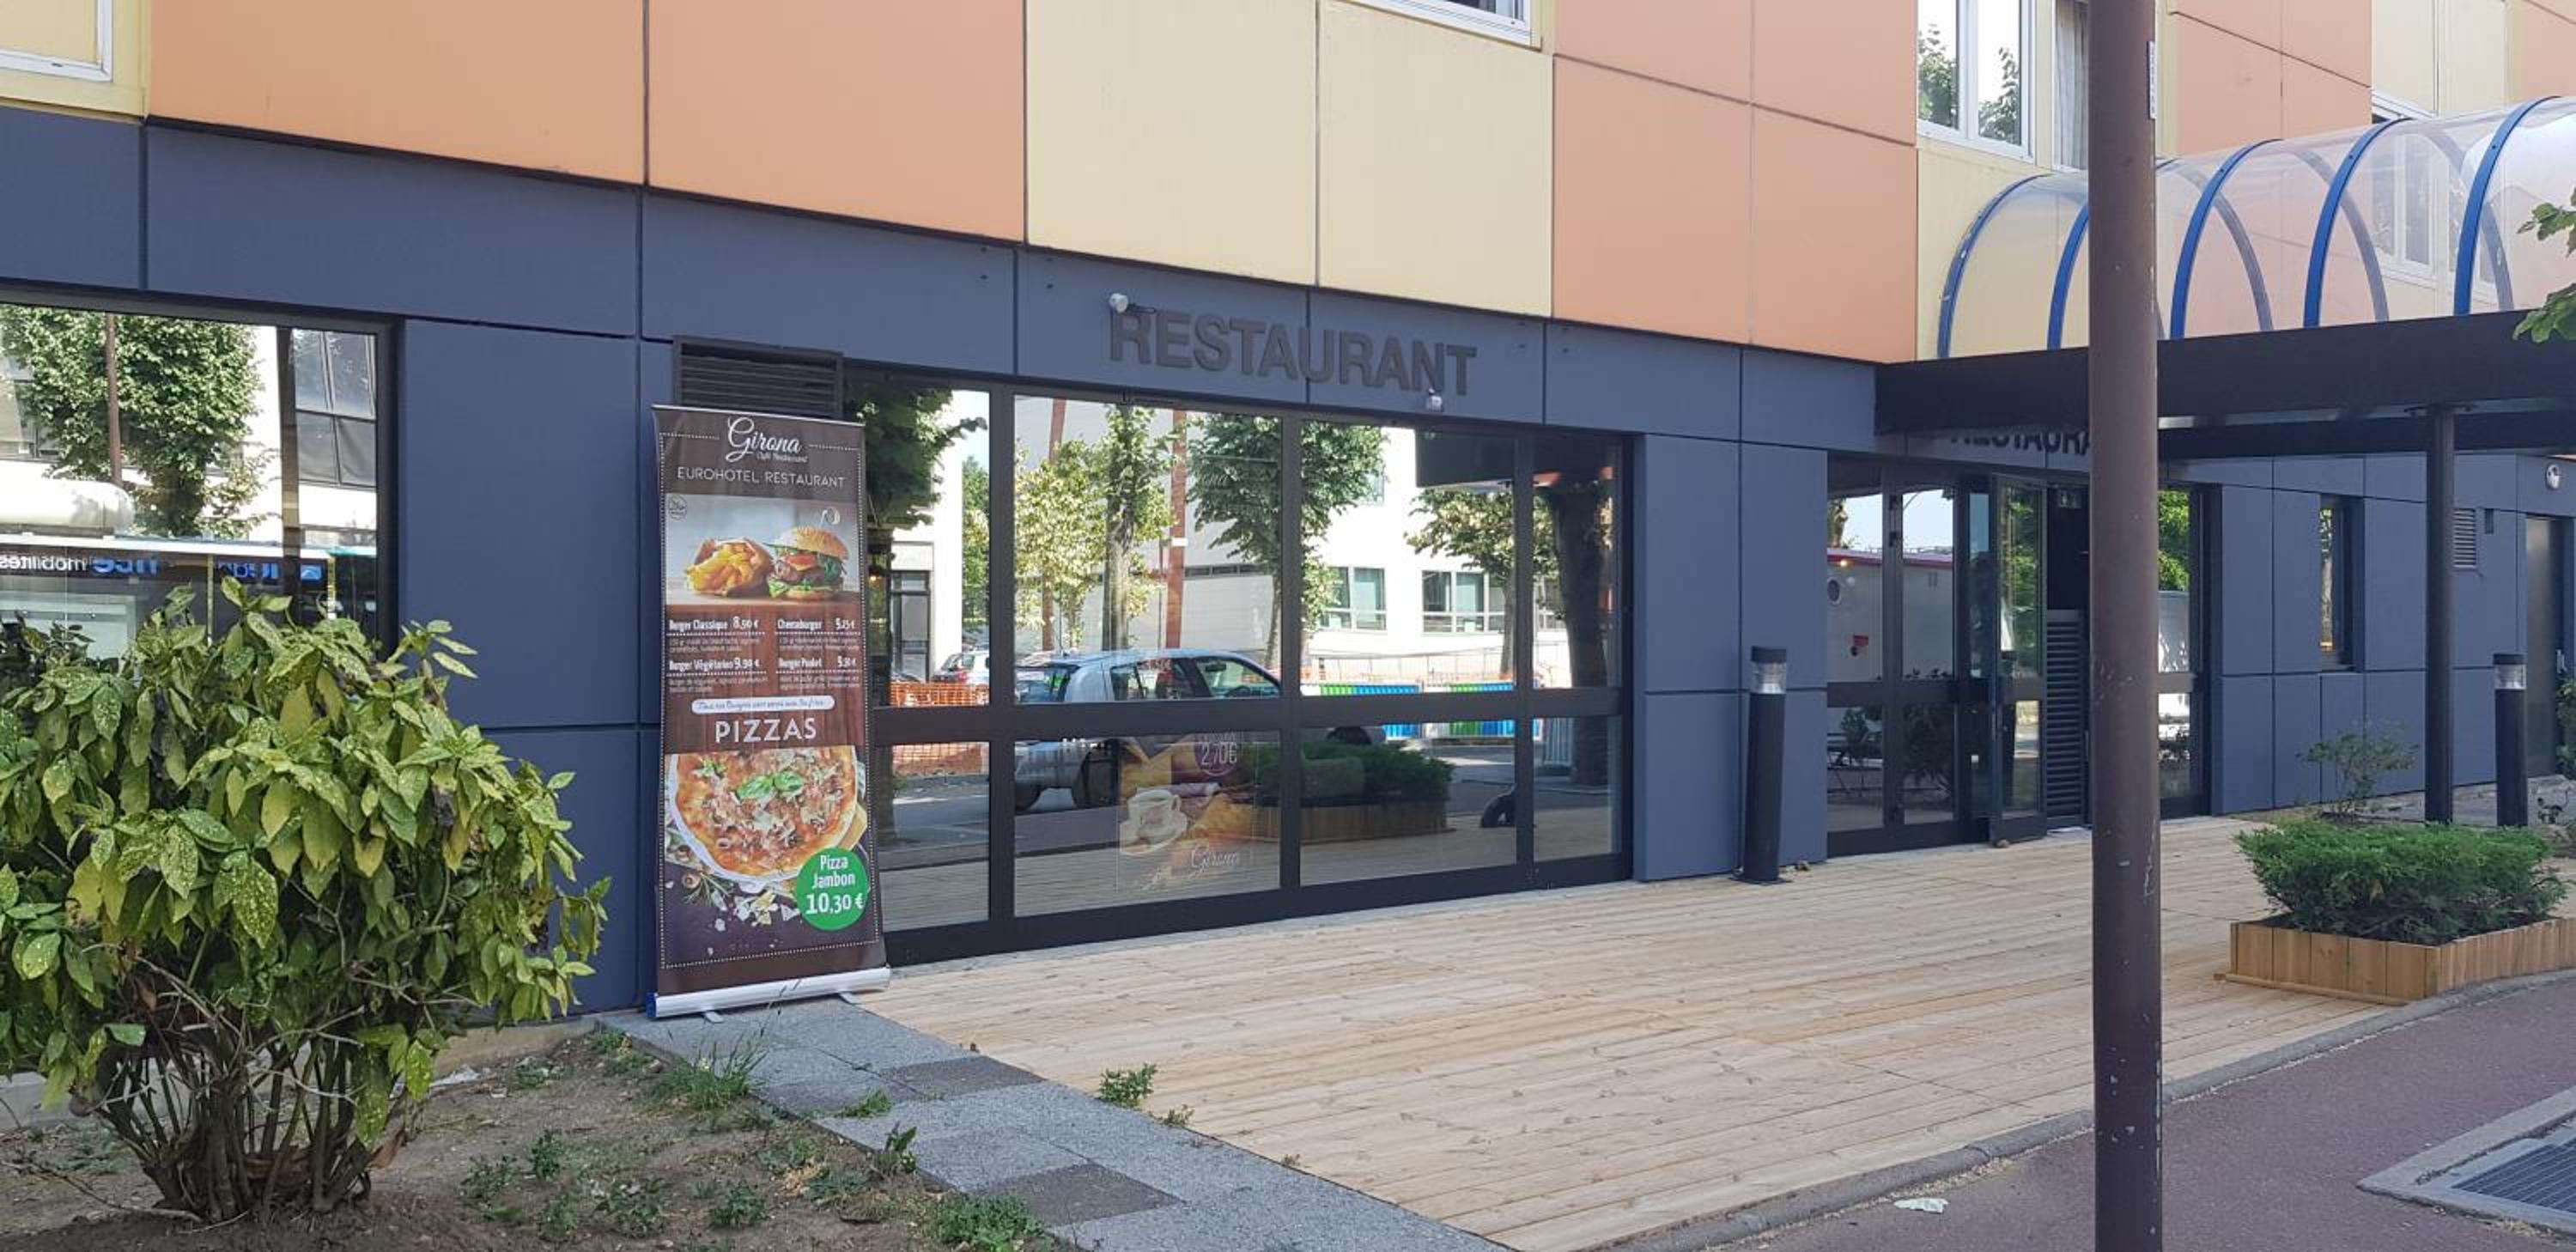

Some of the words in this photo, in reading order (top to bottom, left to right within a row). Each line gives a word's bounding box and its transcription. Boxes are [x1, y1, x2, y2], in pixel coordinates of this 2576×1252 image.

[1109, 310, 1477, 396] RESTAURANT
[726, 417, 802, 462] Girona
[677, 466, 759, 483] EUROHOTEL
[765, 471, 846, 488] RESTAURANT
[669, 619, 691, 632] Burger
[693, 618, 727, 632] Classique
[669, 659, 692, 672] Burger
[714, 718, 817, 744] PIZZAS
[820, 854, 848, 870] Pizza
[811, 870, 856, 890] Jambon
[805, 892, 852, 915] 10,30
[854, 892, 864, 910] €
